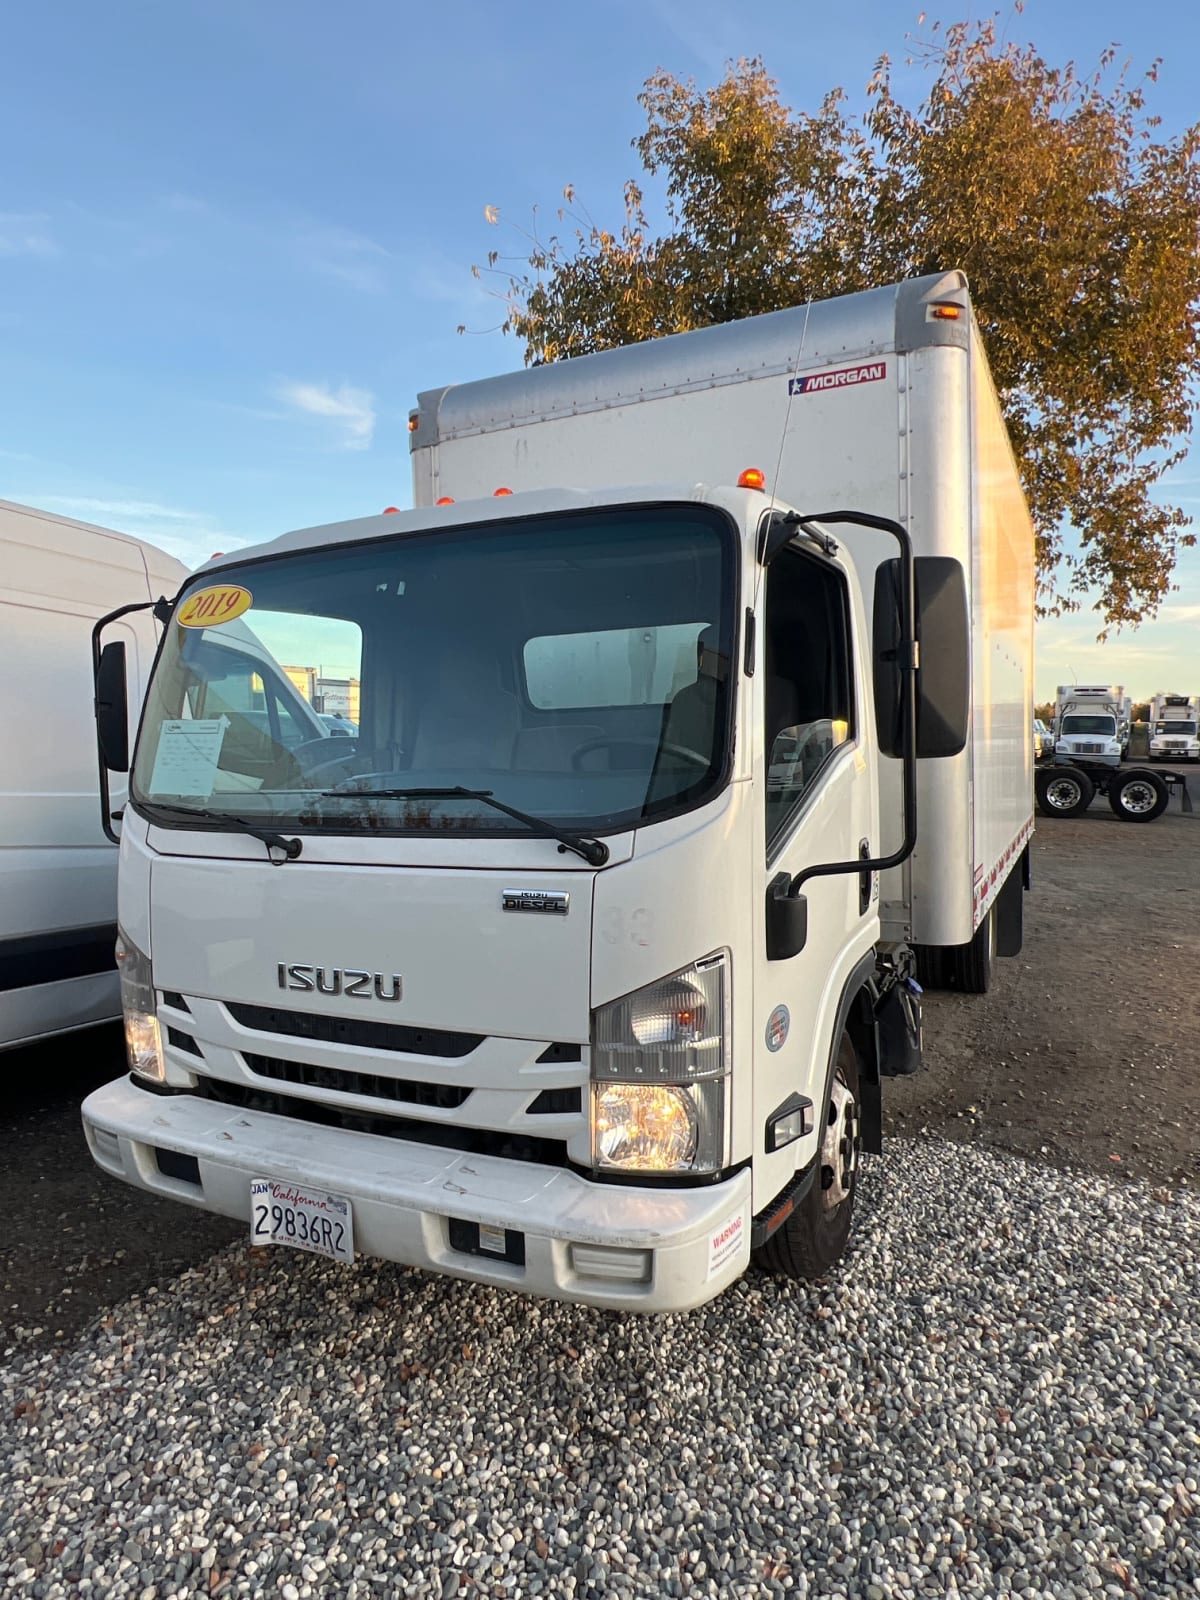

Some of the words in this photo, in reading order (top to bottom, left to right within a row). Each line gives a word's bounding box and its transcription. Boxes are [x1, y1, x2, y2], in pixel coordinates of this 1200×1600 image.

[806, 366, 882, 390] MORGAN
[184, 591, 241, 620] 2019
[504, 899, 565, 912] DIESEL
[278, 961, 402, 1002] ISUZU
[252, 1184, 268, 1194] JAN
[272, 1184, 333, 1212] California
[255, 1204, 346, 1255] 29836R2
